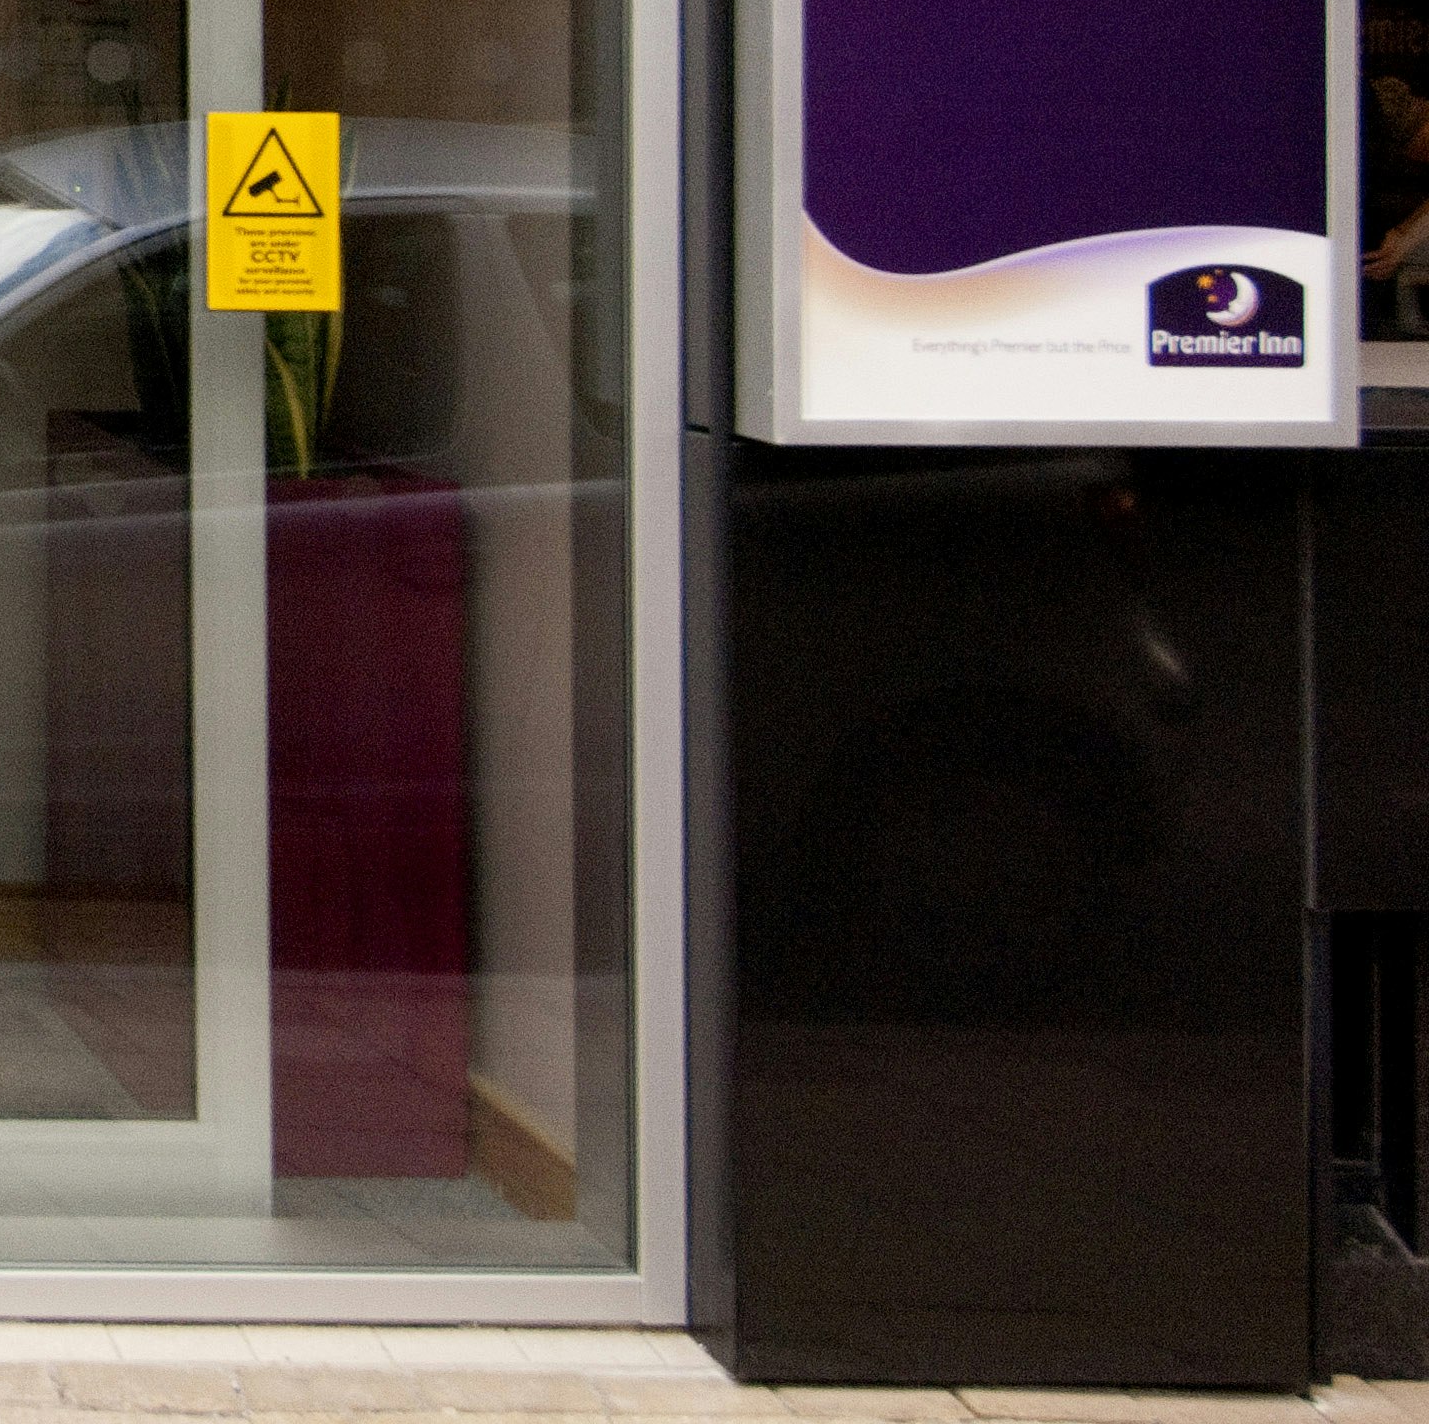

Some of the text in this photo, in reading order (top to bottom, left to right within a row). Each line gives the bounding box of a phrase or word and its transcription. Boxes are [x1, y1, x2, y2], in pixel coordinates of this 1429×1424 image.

[250, 249, 301, 264] CCTV
[990, 338, 1043, 354] Premier
[1046, 339, 1071, 355] but
[1072, 339, 1095, 355] the
[1151, 330, 1302, 356] Premier Inn
